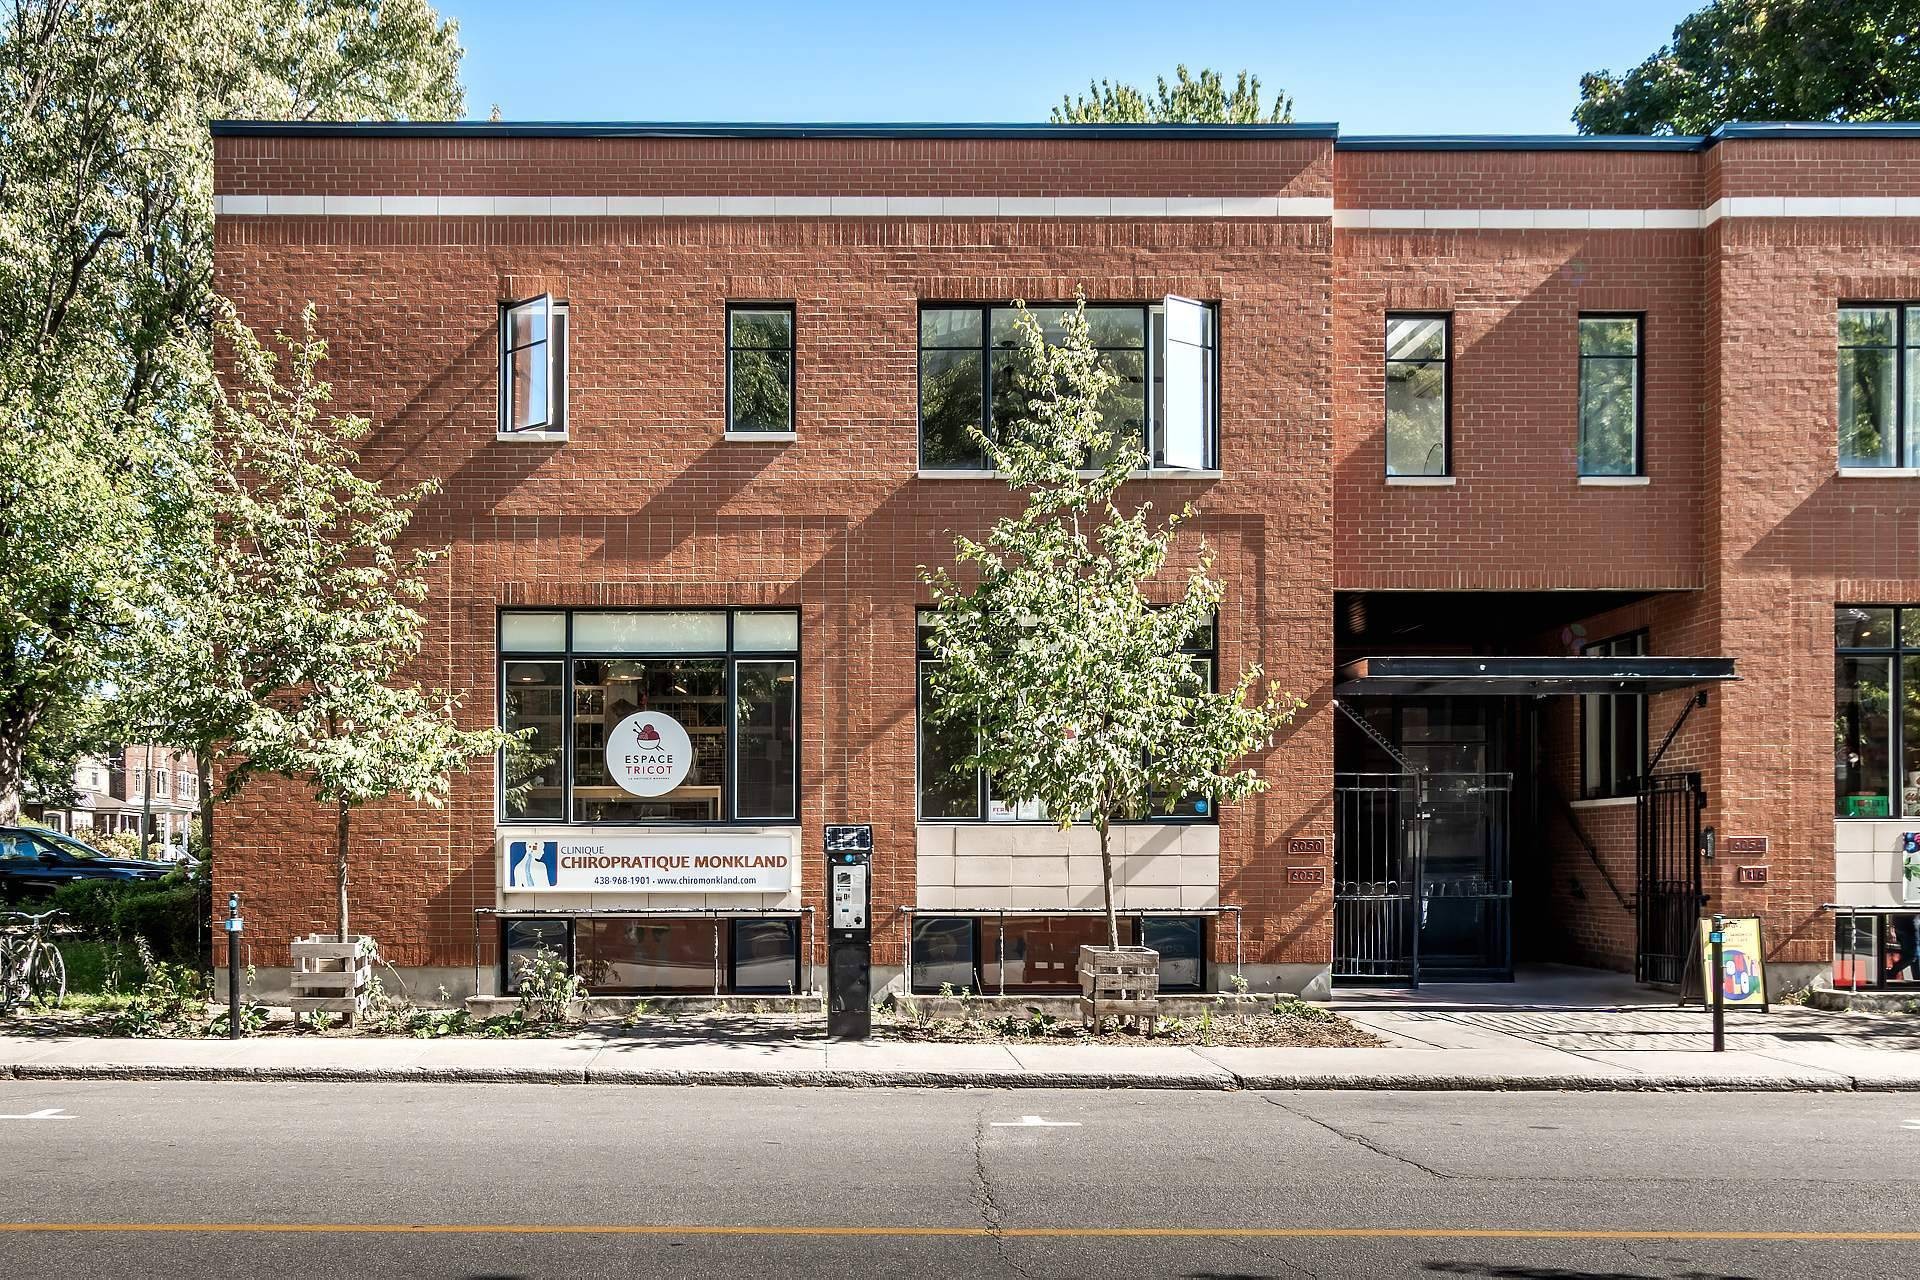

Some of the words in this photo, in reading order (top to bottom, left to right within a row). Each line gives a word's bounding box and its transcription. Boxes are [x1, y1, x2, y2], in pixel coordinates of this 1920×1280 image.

[625, 755, 673, 764] ESPACE
[626, 766, 673, 774] TRICOT
[1292, 841, 1322, 851] 6050
[560, 846, 605, 856] CLINIQUE
[560, 856, 690, 872] CHIROPRATIQUE
[694, 855, 788, 869] MONKLAND
[1292, 871, 1322, 880] 6052
[594, 876, 650, 885] 438-968-1901
[657, 876, 757, 885] www.chiromonkland.com
